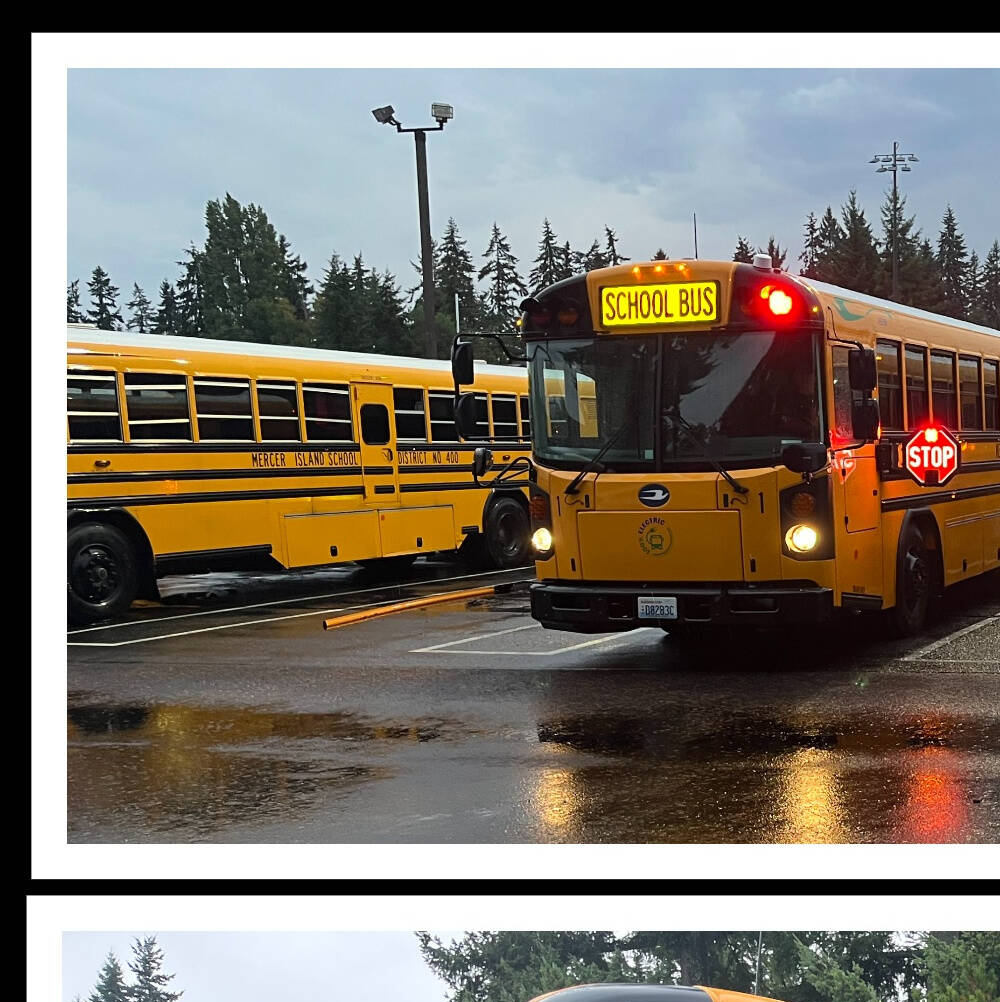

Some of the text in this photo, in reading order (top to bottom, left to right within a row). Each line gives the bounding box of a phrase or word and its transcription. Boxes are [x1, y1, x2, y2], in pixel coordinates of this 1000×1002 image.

[605, 286, 714, 321] SCHOOL BUS
[251, 451, 459, 467] MERCER ISLAND SCHOOL DISTRICT NO 400
[909, 445, 954, 468] STOP
[758, 492, 764, 514] 1
[638, 516, 666, 535] ELECTRIC
